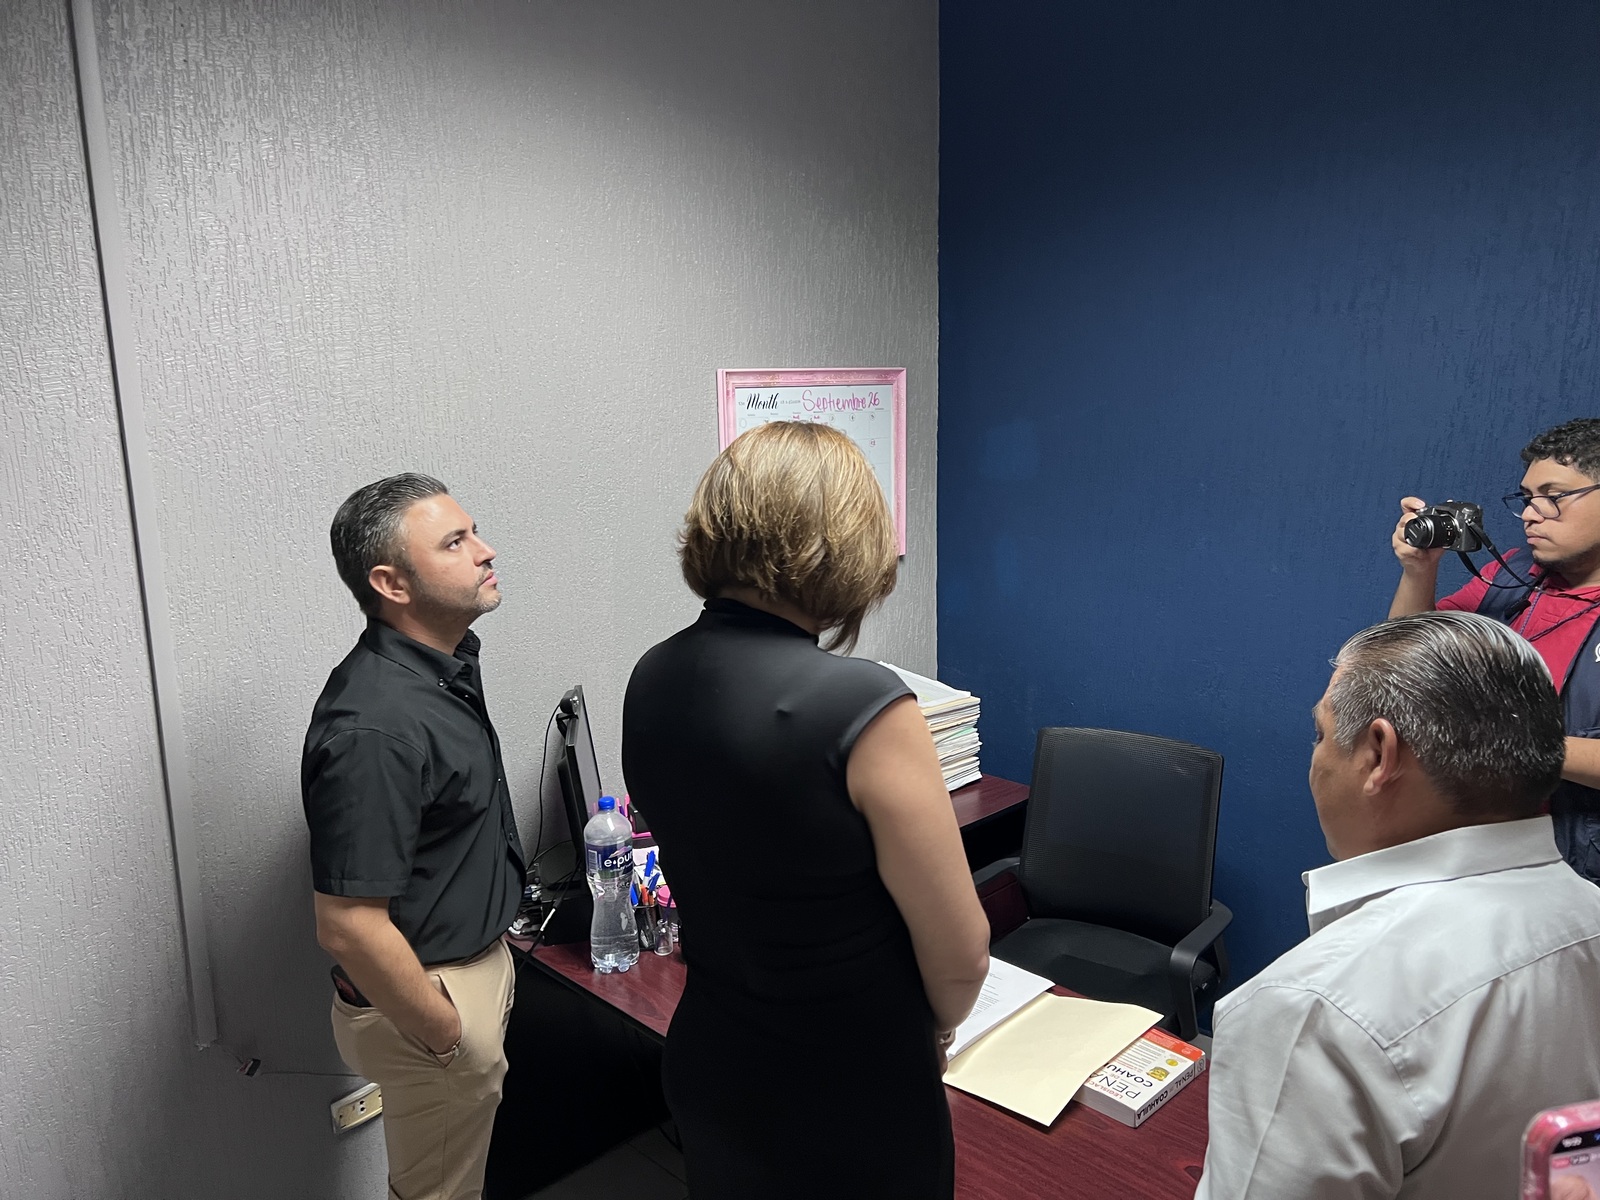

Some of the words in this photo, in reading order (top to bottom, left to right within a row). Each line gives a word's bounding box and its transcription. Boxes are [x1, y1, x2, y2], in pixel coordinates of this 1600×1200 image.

[746, 392, 780, 410] Month
[802, 389, 867, 412] Septiembre
[1174, 1069, 1194, 1089] PENAL
[1136, 1090, 1169, 1121] COAHUILA
